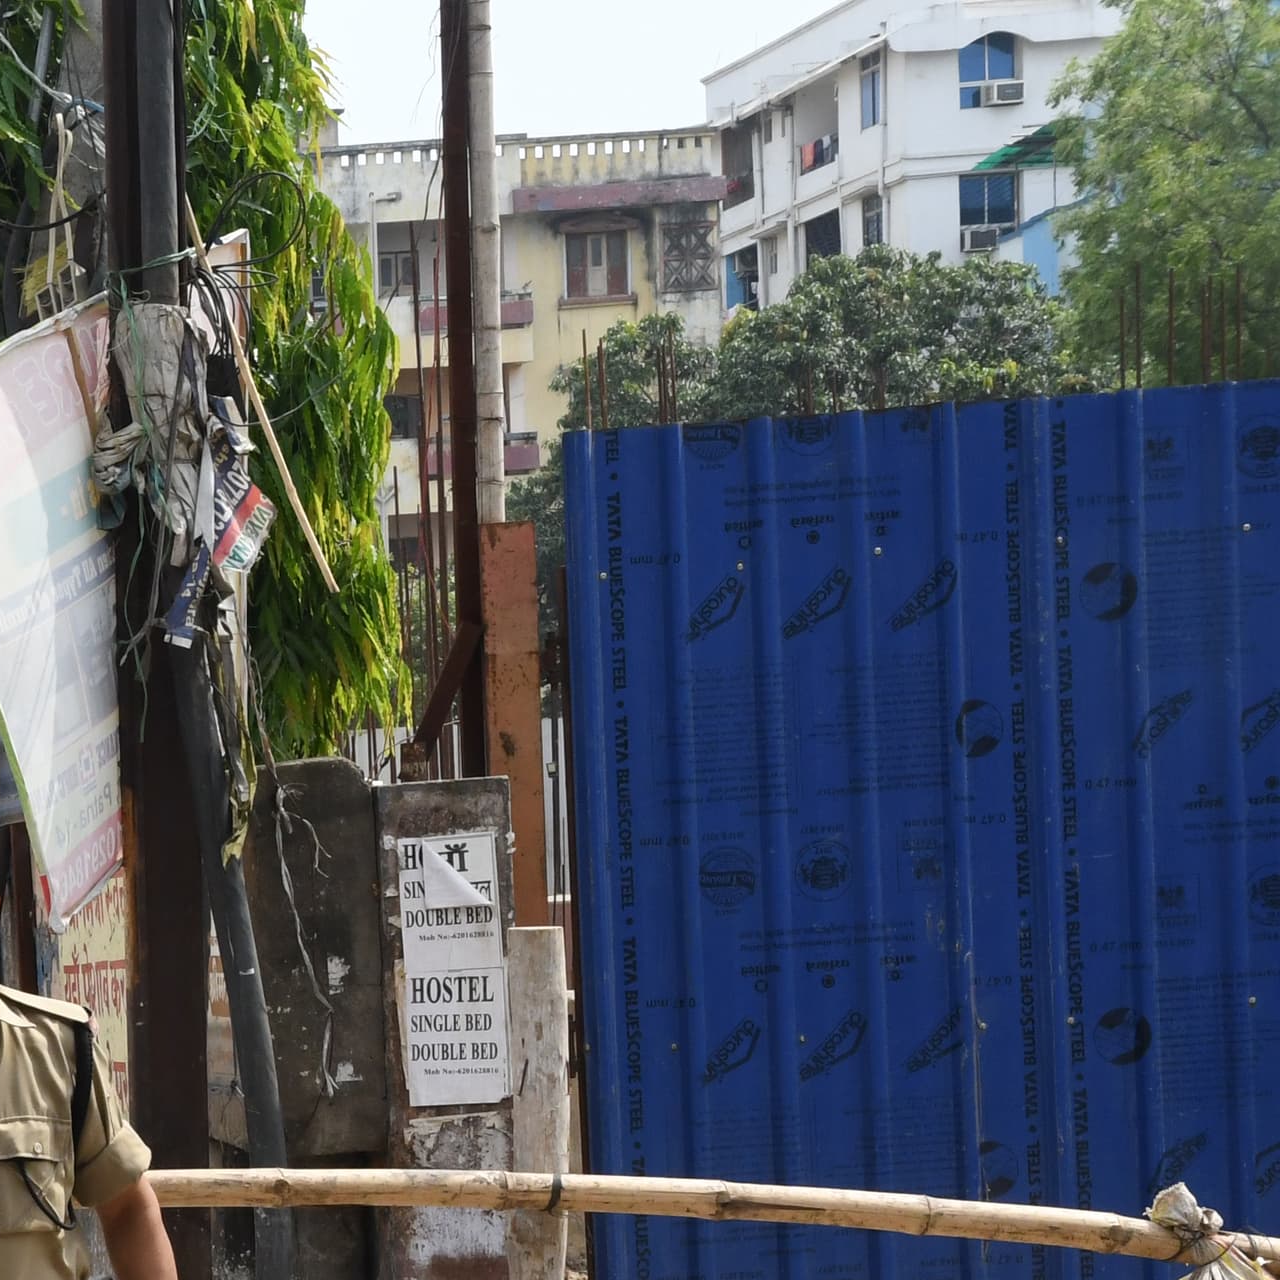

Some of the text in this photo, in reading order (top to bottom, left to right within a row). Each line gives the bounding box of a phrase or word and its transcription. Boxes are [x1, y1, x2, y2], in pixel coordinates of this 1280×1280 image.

[605, 429, 621, 465] TEEL
[1004, 402, 1019, 451] TATA
[1052, 420, 1068, 470] TATA
[606, 492, 622, 541] TATA
[1053, 474, 1072, 571] BLUESCOPE
[608, 546, 626, 641] BLUESCOPE
[1004, 479, 1024, 677] TATA BLUESCOPE STEEL
[1055, 576, 1072, 623] STEEL
[611, 646, 627, 694] STEEL
[1059, 644, 1075, 694] TATA
[614, 715, 630, 762] TATA
[1060, 698, 1078, 792] BLUESCOPE
[615, 767, 633, 861] BLUESCOPE
[1011, 702, 1033, 898] TATA BLUESCOPE STEEL
[1063, 795, 1079, 842] STEEL
[403, 880, 425, 900] SIN
[618, 866, 635, 912] STEEL
[1064, 868, 1082, 916] TATA
[405, 905, 493, 929] DOUBLE BED
[622, 937, 639, 986] TATA
[1066, 920, 1085, 1016] BLUESCOPE
[410, 975, 495, 1004] HOSTEL
[410, 1013, 492, 1033] SINGLE BED
[624, 990, 643, 1083] BLUESCOPE
[1019, 925, 1040, 1119] TATA BLUESCOPE STEEL
[1070, 1020, 1088, 1065] STEEL
[411, 1041, 498, 1062] DOUBLE BED
[628, 1088, 644, 1135] STEEL
[1073, 1087, 1089, 1137] TATA
[1026, 1141, 1041, 1186] STEEL
[1076, 1139, 1093, 1211] BLUESCO
